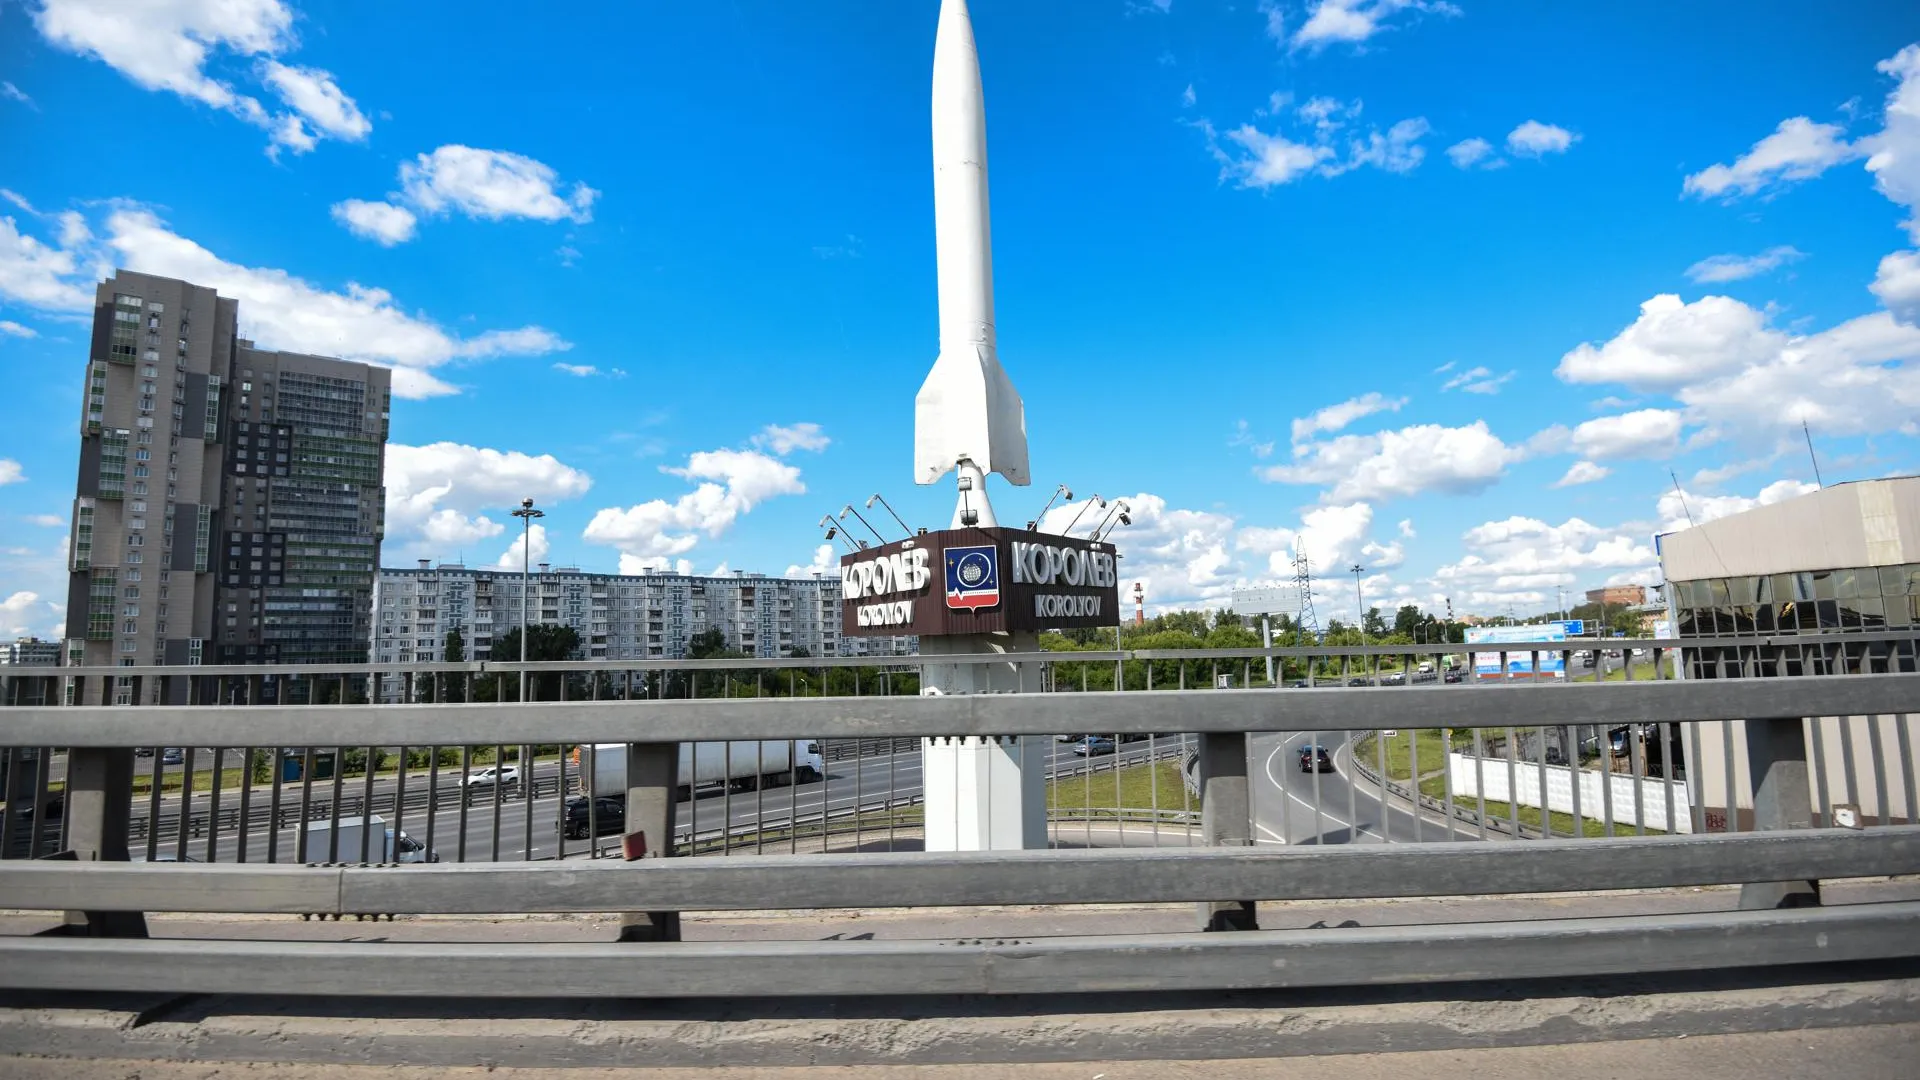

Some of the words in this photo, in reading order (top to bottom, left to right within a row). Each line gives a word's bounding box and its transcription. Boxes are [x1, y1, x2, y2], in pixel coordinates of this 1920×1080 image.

[842, 541, 930, 599] КОРОЛЁВ
[1011, 542, 1116, 588] КОРОЛЁВ
[857, 600, 915, 626] KOROLYOV
[1035, 594, 1101, 617] KOROLYOV
